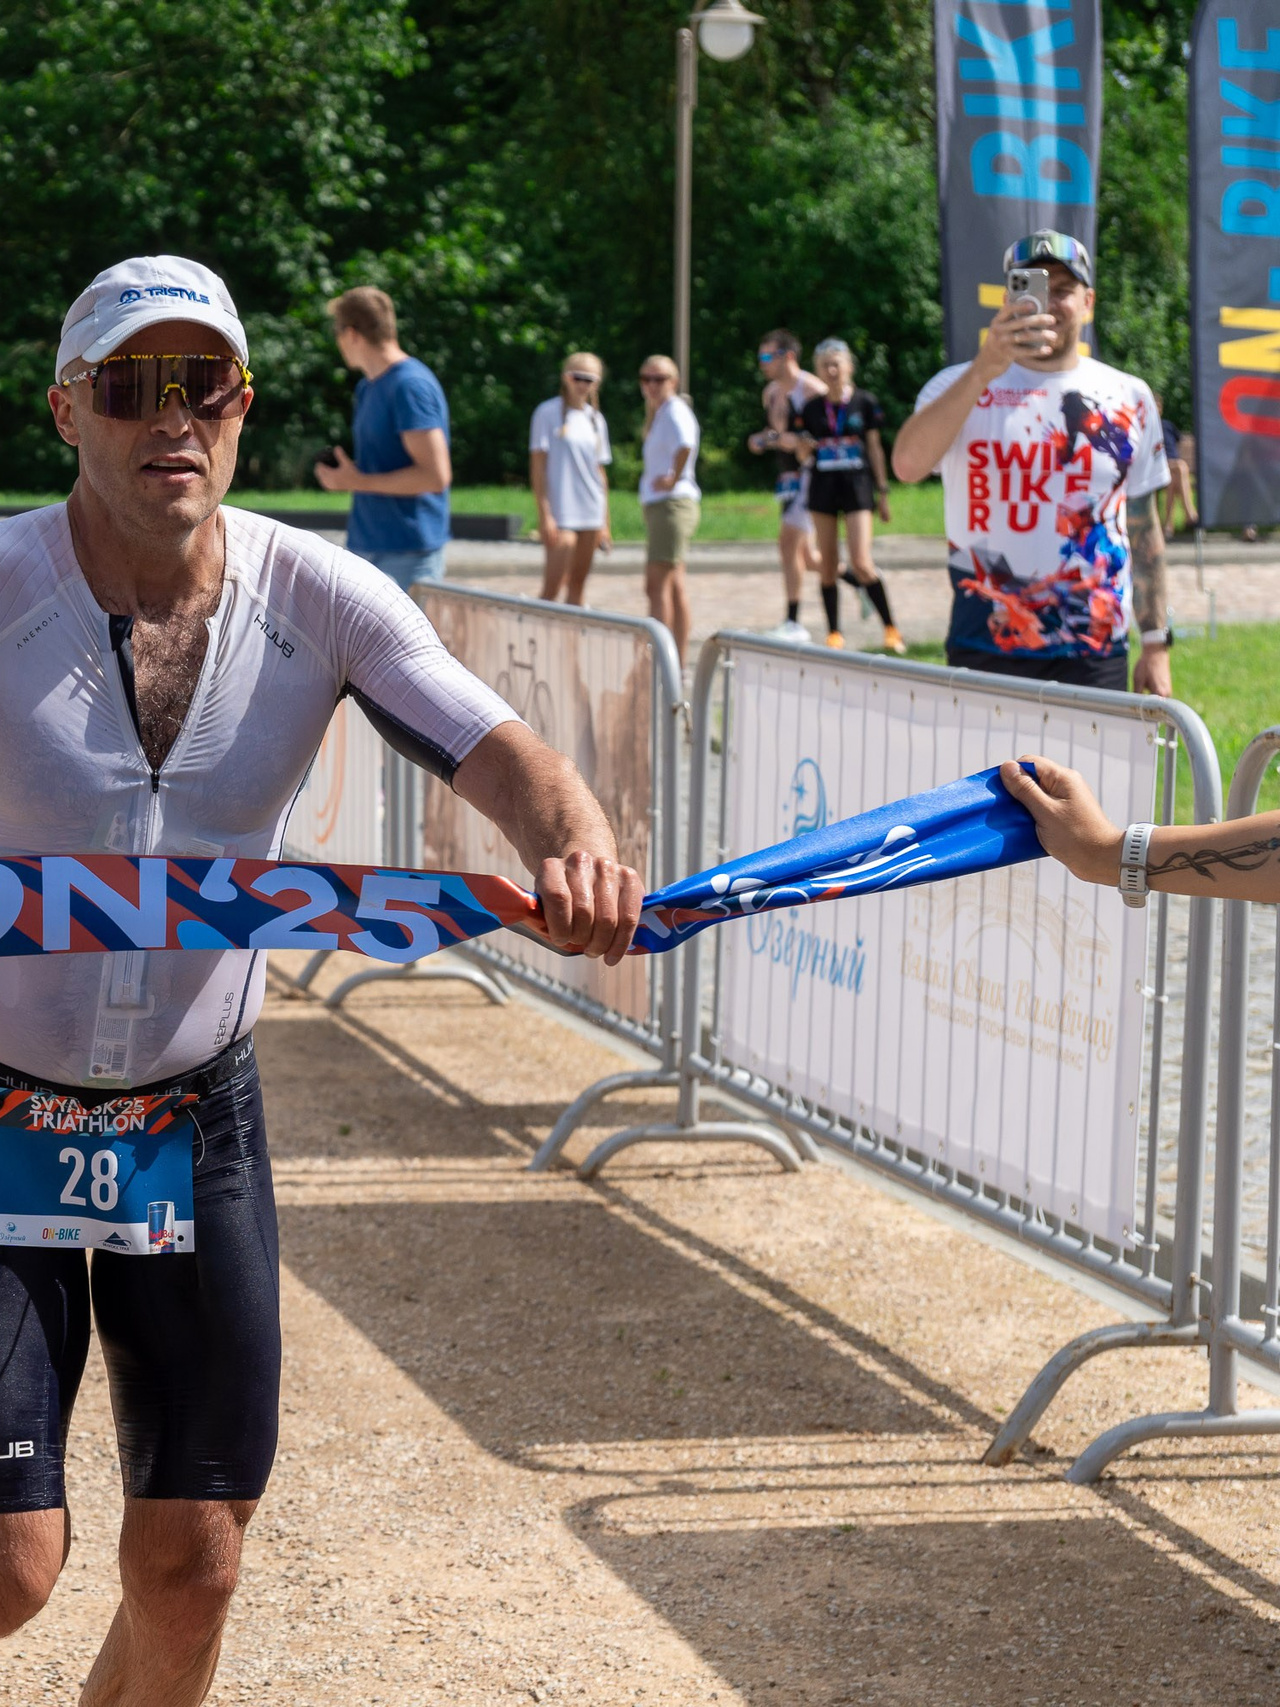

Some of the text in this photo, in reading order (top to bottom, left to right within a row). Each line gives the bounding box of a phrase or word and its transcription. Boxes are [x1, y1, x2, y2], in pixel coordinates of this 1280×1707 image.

[144, 286, 210, 306] TRISTYLE
[967, 501, 1093, 535] RU
[254, 614, 295, 659] HUUB
[30, 1109, 146, 1133] TRIATHLON
[58, 1147, 119, 1211] 28
[42, 1227, 81, 1241] ON-BIKE
